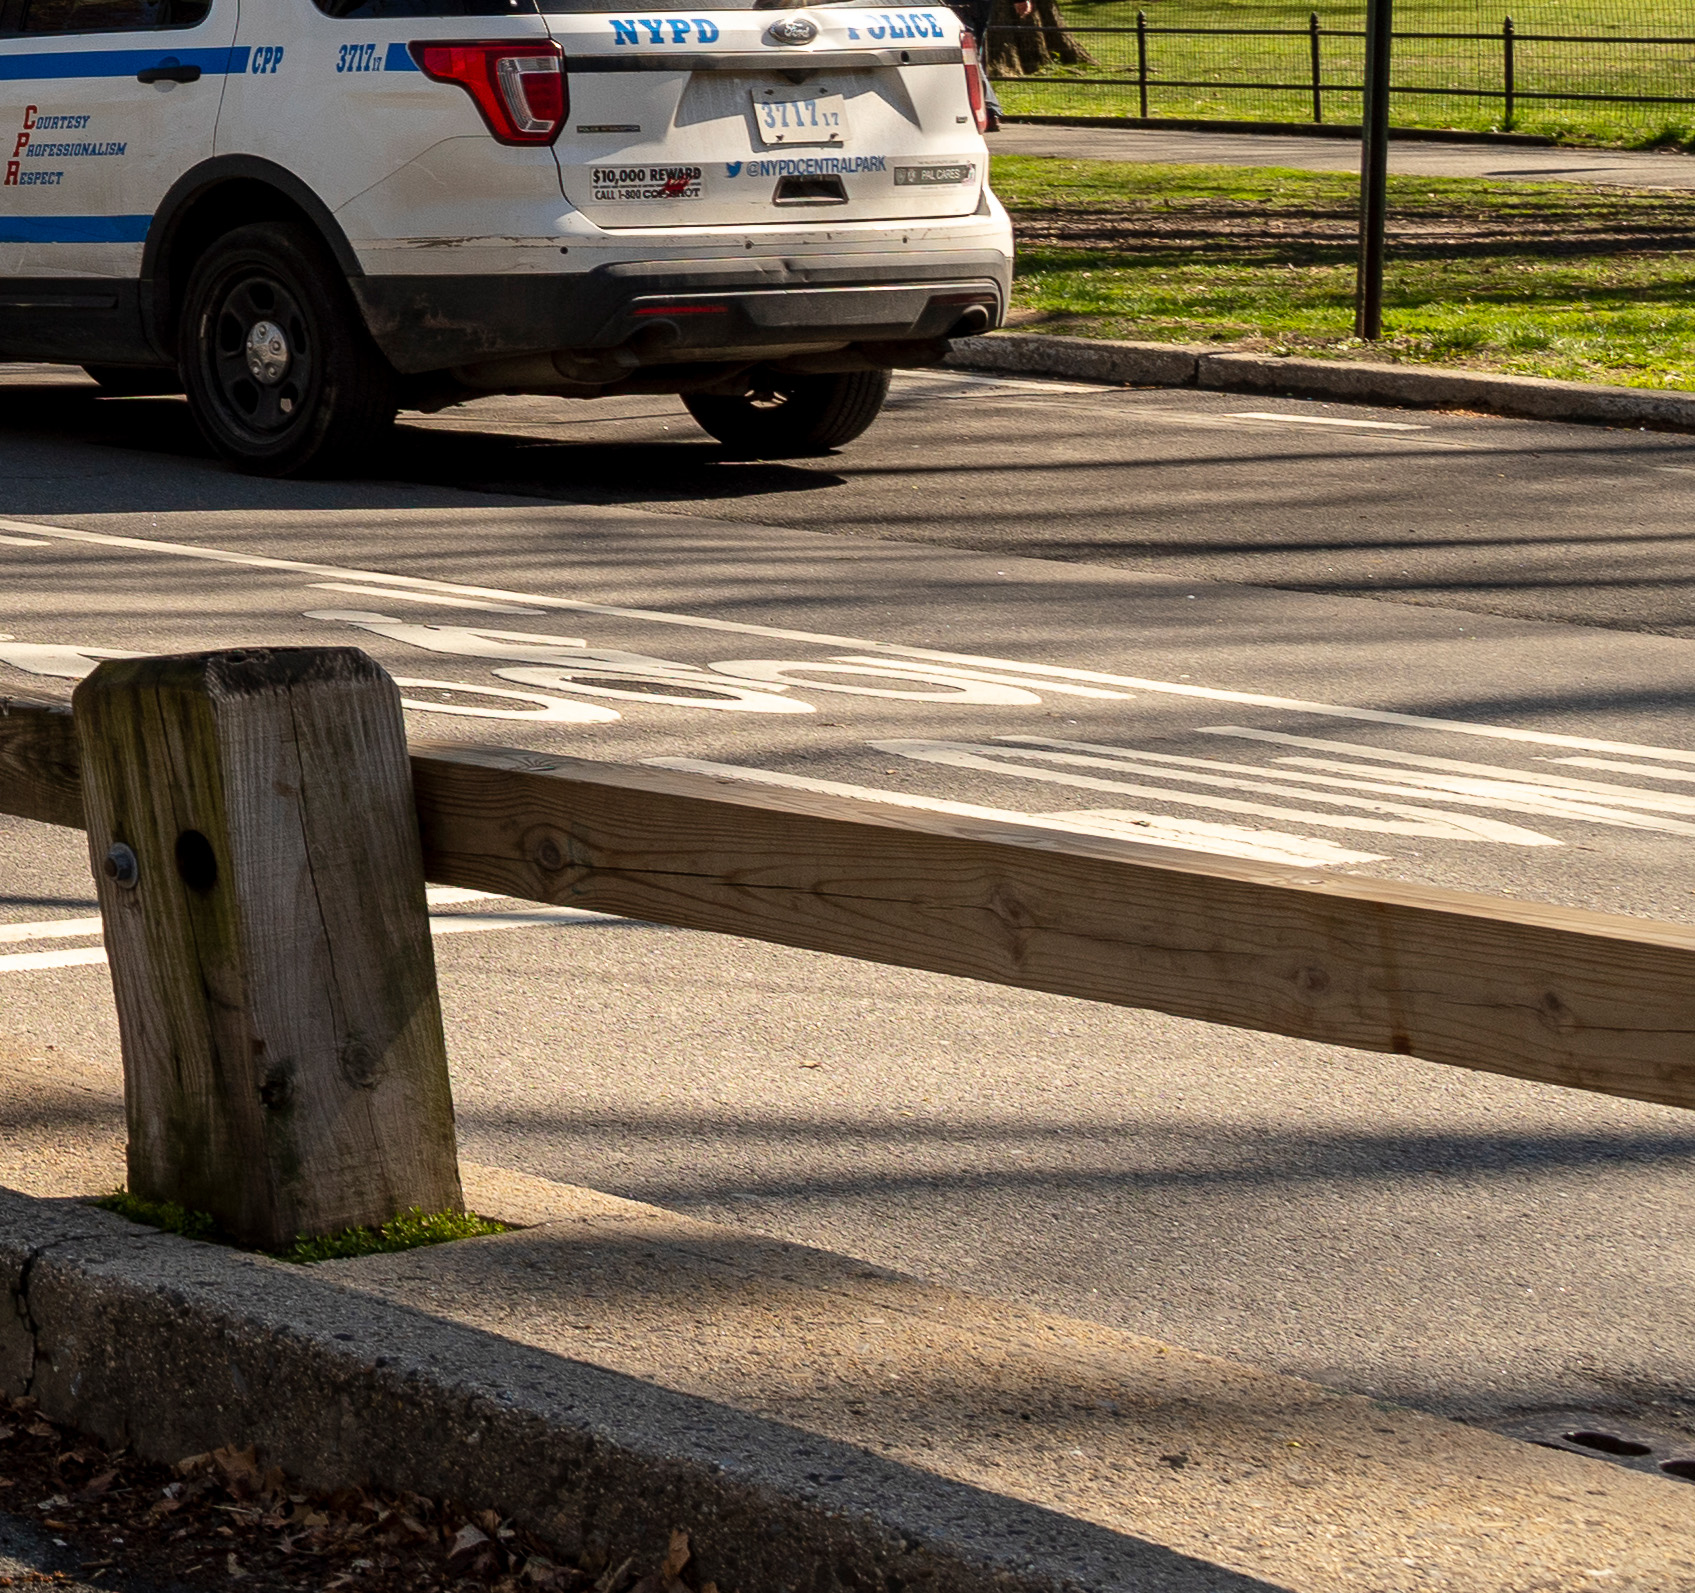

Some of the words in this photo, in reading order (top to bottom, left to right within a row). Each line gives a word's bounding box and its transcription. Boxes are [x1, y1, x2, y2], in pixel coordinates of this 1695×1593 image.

[608, 19, 720, 45] NYPD
[251, 46, 284, 74] CPP
[336, 43, 376, 73] 3717
[372, 56, 383, 72] 17
[22, 104, 91, 130] COURTESY
[761, 100, 819, 129] 3717
[822, 112, 839, 126] 17
[12, 132, 127, 158] PROFESSIONALISM
[4, 160, 64, 186] RESPECT
[592, 168, 645, 185] $10,000
[649, 167, 702, 182] REWARD
[746, 156, 886, 177] @NYPDCENTRALPARK
[921, 169, 936, 181] PAL
[936, 168, 961, 180] CARES
[594, 189, 616, 200] CALL
[618, 189, 641, 200] 1-800
[638, 725, 1695, 868] LOW
